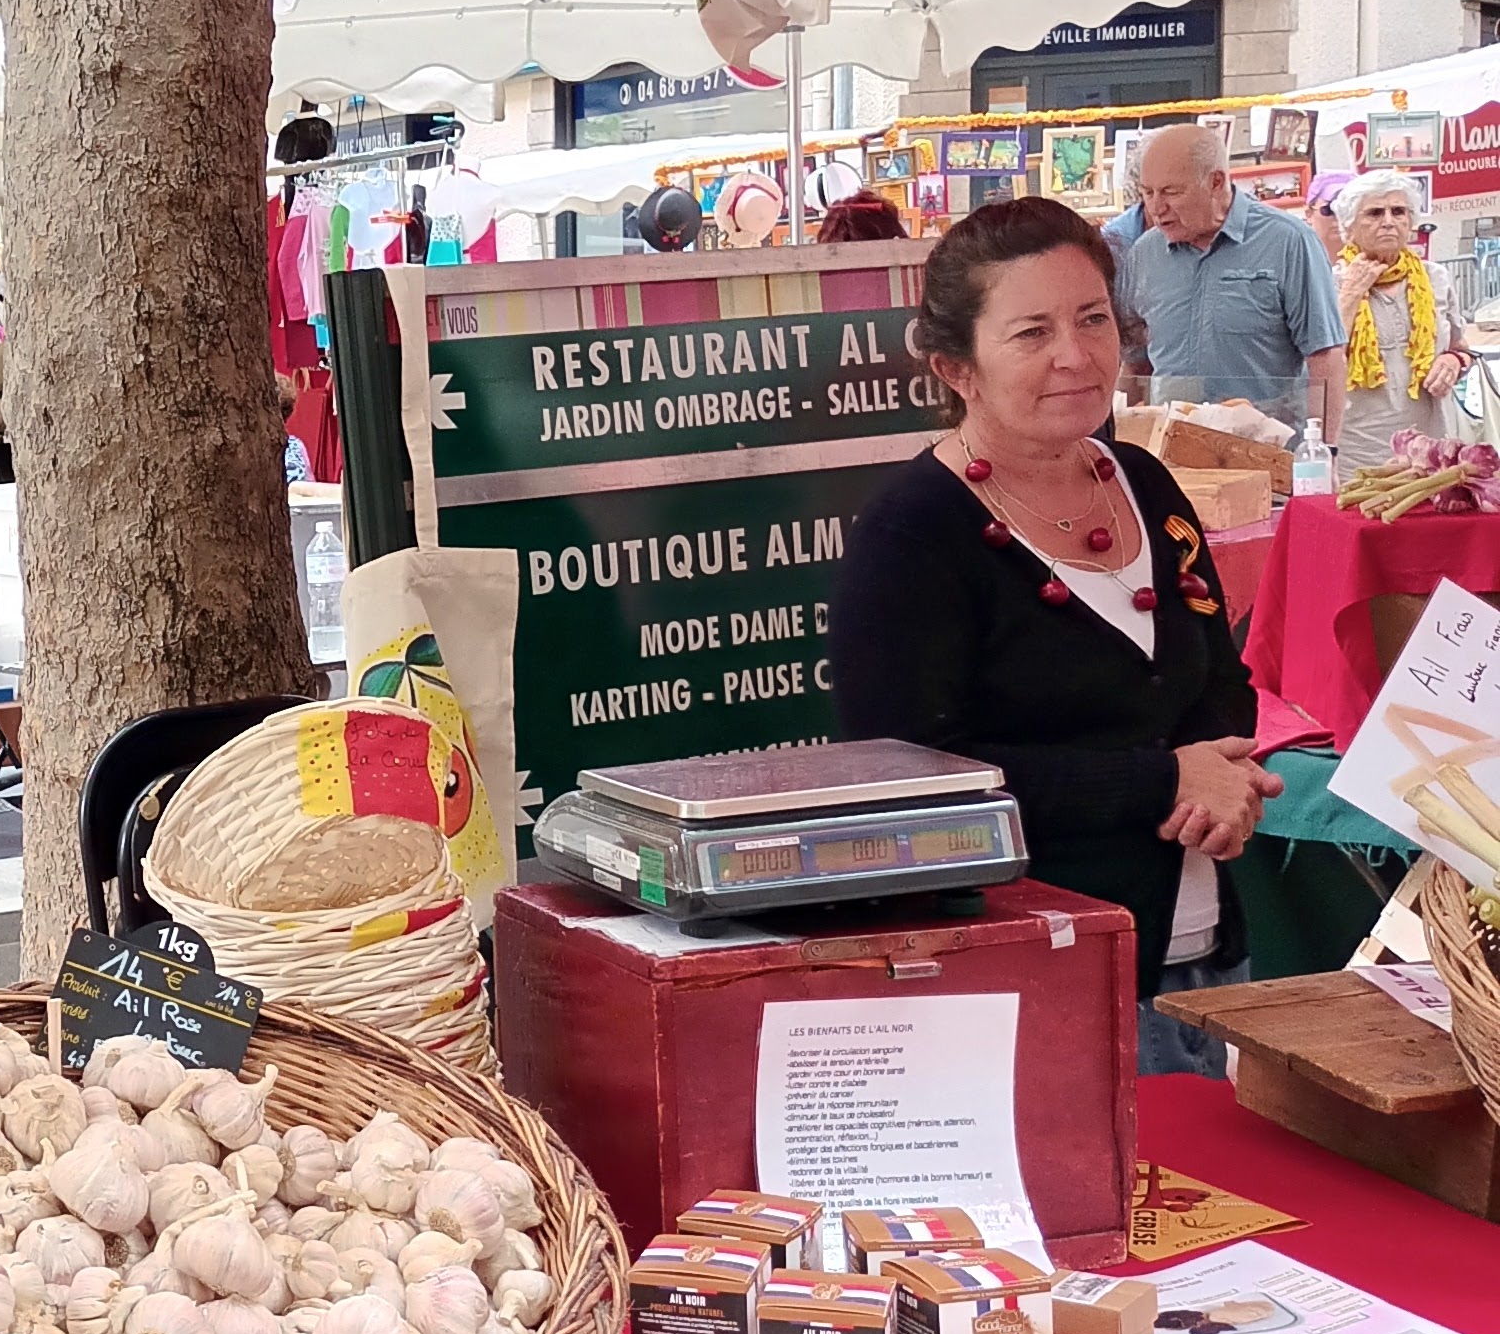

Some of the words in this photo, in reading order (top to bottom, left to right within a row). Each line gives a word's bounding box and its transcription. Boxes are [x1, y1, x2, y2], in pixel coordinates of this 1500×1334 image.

[1096, 22, 1185, 41] IMMOBILIER
[637, 79, 654, 102] 04
[446, 306, 479, 335] VOUS
[531, 325, 811, 392] RESTAURANT
[839, 321, 886, 367] AL
[540, 398, 645, 442] JARDIN
[655, 385, 792, 430] OMBRAGE
[828, 377, 900, 416] SALLE
[528, 527, 748, 596] BOUTIQUE
[640, 615, 721, 658] MODE
[730, 605, 805, 646] DAME
[570, 678, 692, 727] KARTING
[723, 662, 804, 705] PAUSE
[1408, 656, 1450, 697] Ail
[157, 926, 199, 963] 1kg
[96, 949, 144, 987] 14
[113, 989, 150, 1017] Ail
[670, 1293, 683, 1305] AIL
[685, 1295, 707, 1307] NOIR
